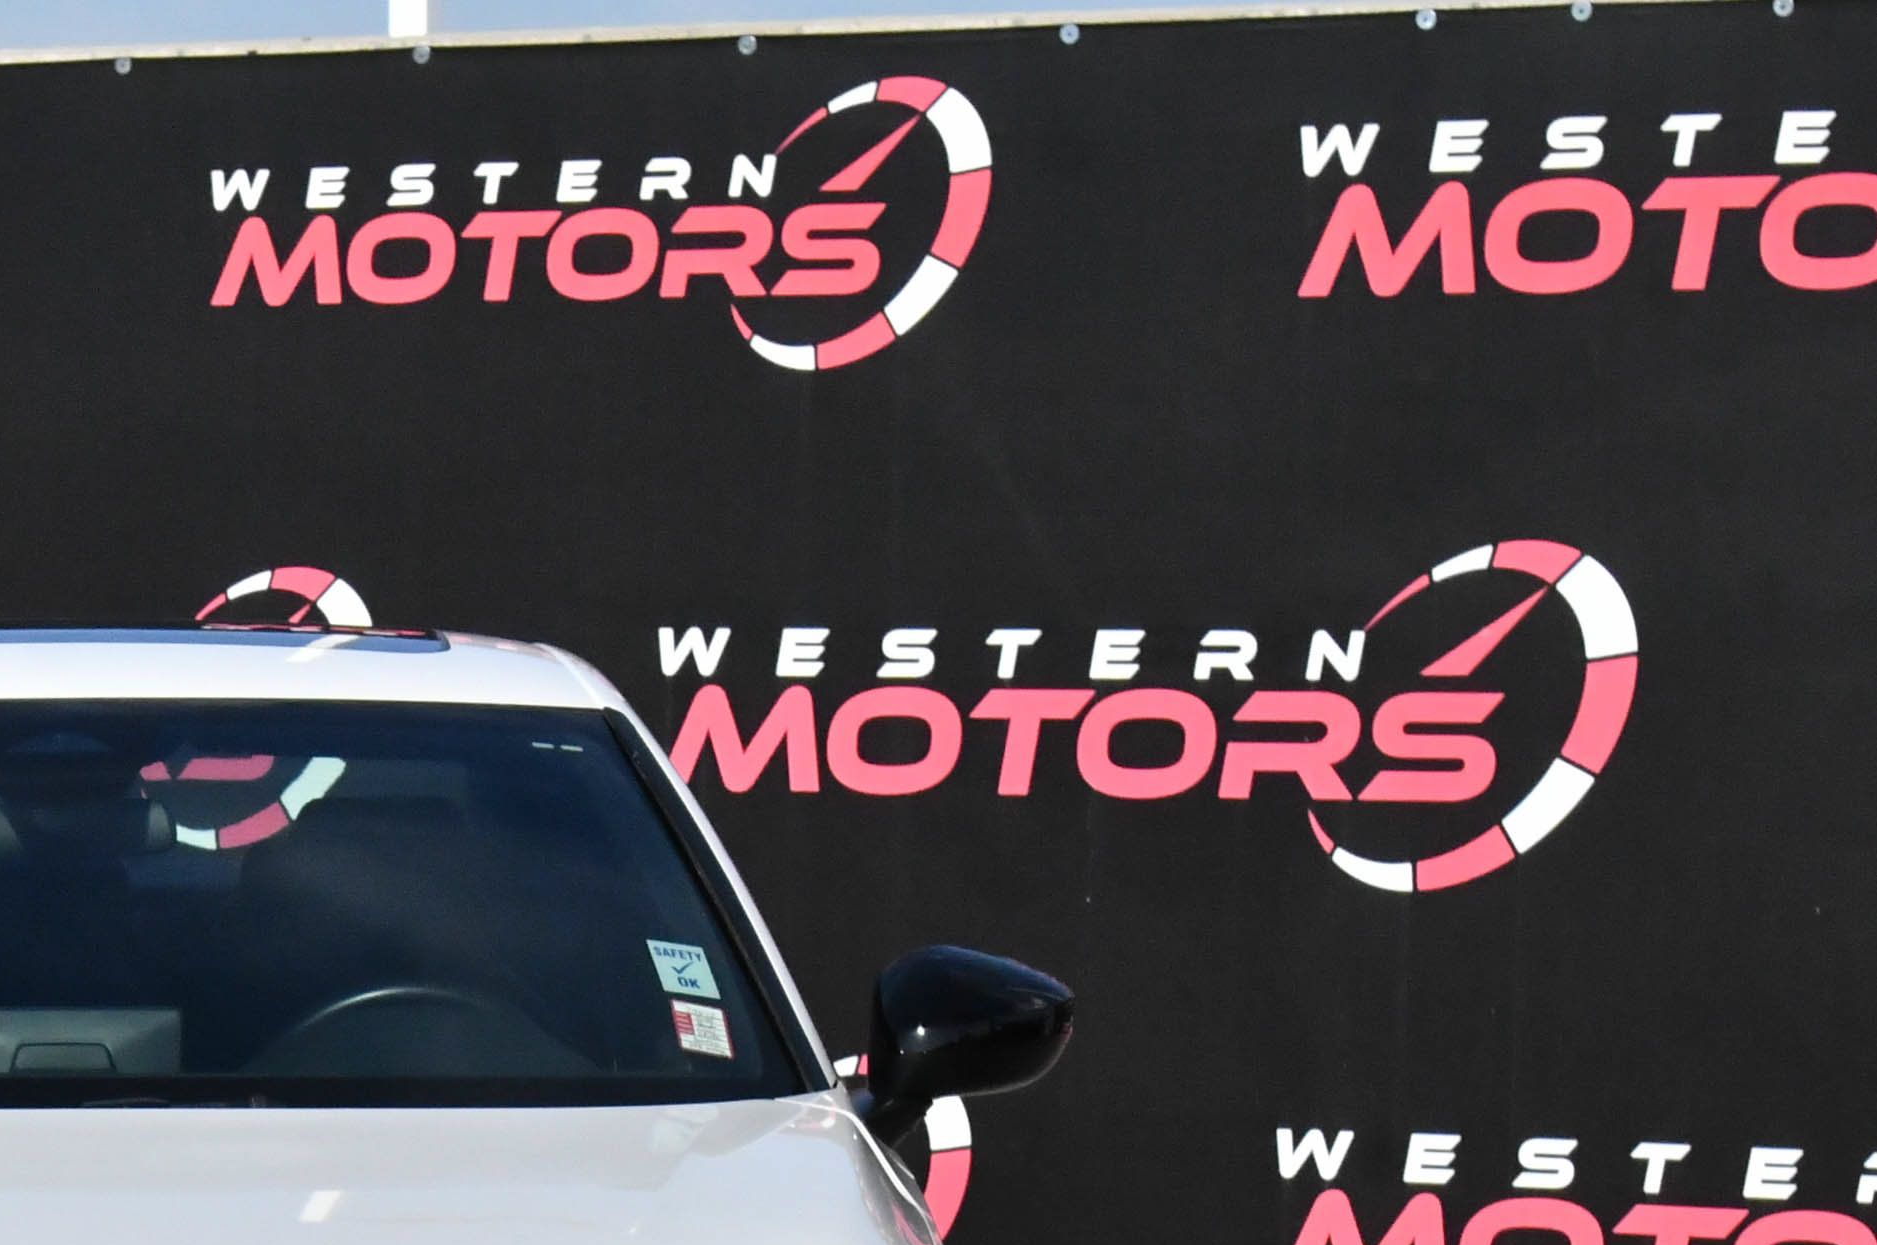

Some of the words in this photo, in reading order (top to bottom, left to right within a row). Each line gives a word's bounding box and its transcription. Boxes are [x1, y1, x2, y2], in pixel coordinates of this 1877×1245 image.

[1300, 110, 1837, 178] WESTE
[210, 153, 777, 212] WESTERN
[210, 202, 887, 307] MOTORS
[658, 626, 1366, 682] WESTERN
[669, 684, 1505, 803] MOTORS
[653, 946, 703, 962] SAFETY
[677, 977, 701, 990] OK
